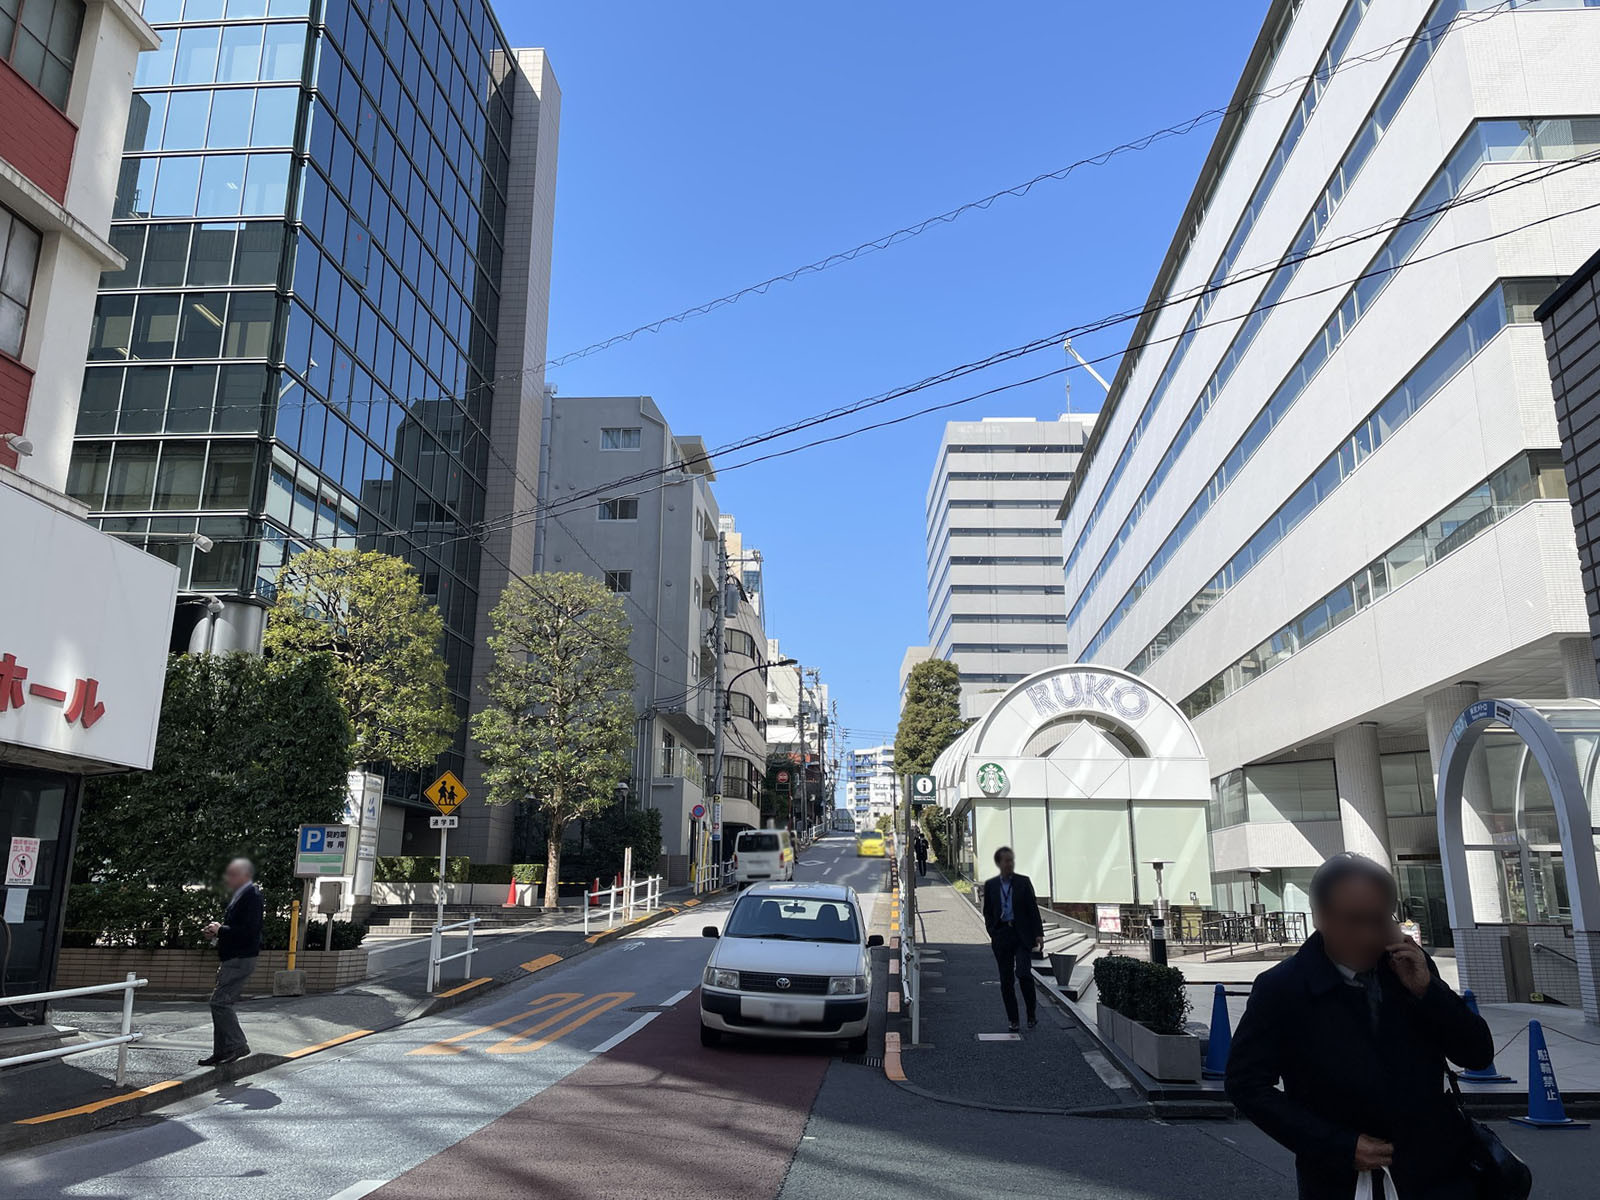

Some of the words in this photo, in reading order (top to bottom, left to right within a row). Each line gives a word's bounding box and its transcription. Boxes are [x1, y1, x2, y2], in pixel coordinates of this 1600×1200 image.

[0, 653, 105, 728] ホール
[1026, 673, 1150, 720] RUKO
[306, 831, 321, 849] P
